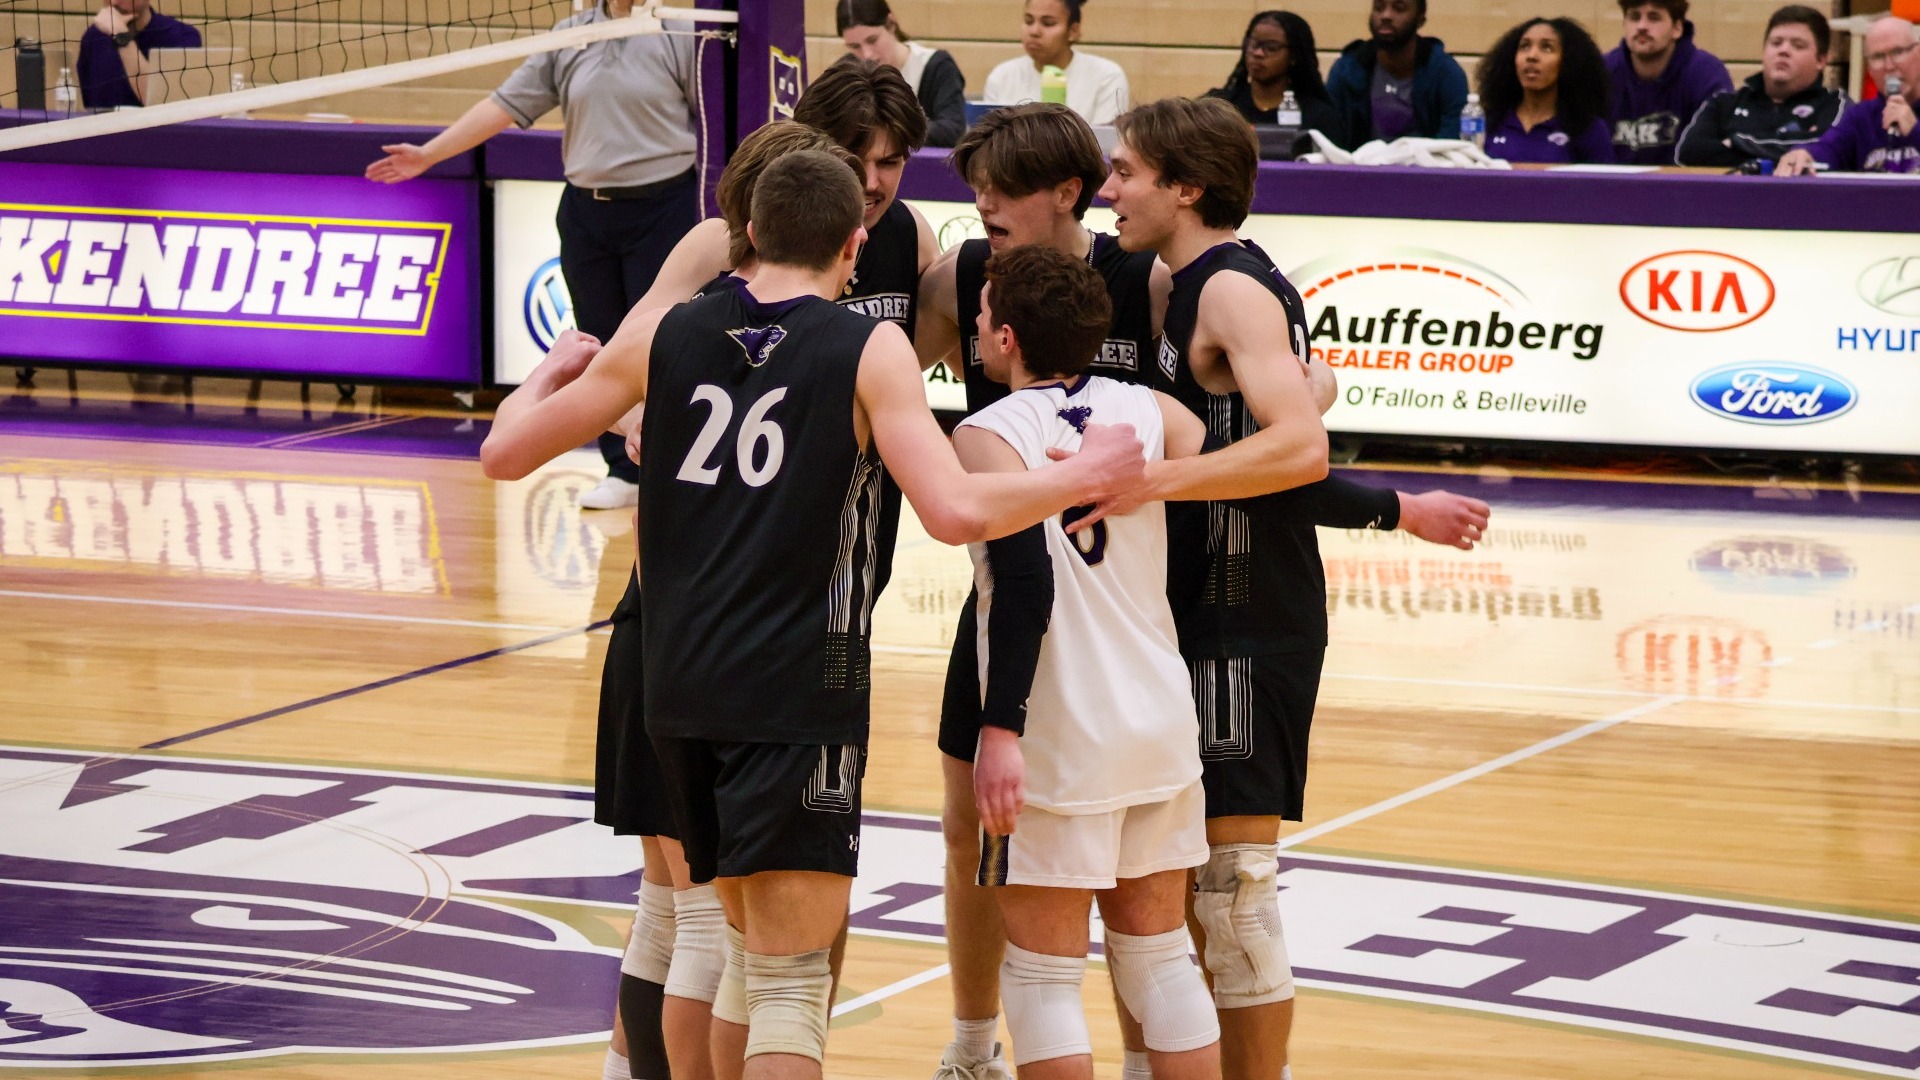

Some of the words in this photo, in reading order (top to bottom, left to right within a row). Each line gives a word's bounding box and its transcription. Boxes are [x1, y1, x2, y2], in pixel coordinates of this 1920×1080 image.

[0, 216, 437, 322] KENDREE
[1647, 269, 1748, 313] KIA
[1310, 306, 1604, 361] Auffenberg
[1419, 352, 1514, 373] GROUP
[1346, 386, 1444, 409] O'Fallon
[1453, 390, 1468, 409] &
[1478, 391, 1587, 414] Belleville
[1721, 369, 1824, 416] Ford
[676, 384, 788, 487] 26
